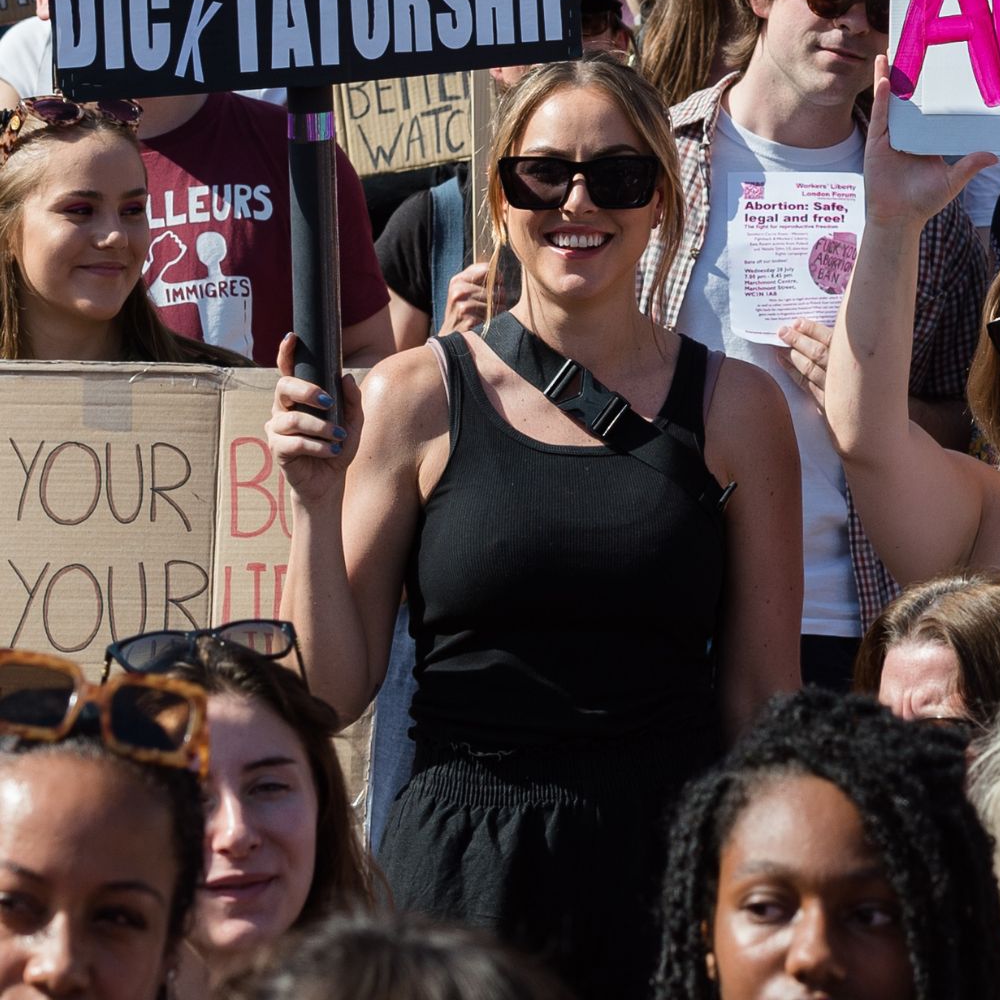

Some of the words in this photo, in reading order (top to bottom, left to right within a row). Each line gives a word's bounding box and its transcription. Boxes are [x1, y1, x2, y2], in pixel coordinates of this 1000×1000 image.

[830, 183, 857, 191] Liberty
[801, 190, 831, 198] London
[744, 201, 809, 211] Abortion:
[813, 201, 849, 214] Safe,
[744, 213, 779, 225] legal
[783, 213, 809, 223] and
[813, 213, 845, 223] free!
[165, 277, 251, 303] IMMIGRES
[8, 437, 193, 533] YOUR
[7, 558, 210, 654] YOUR
